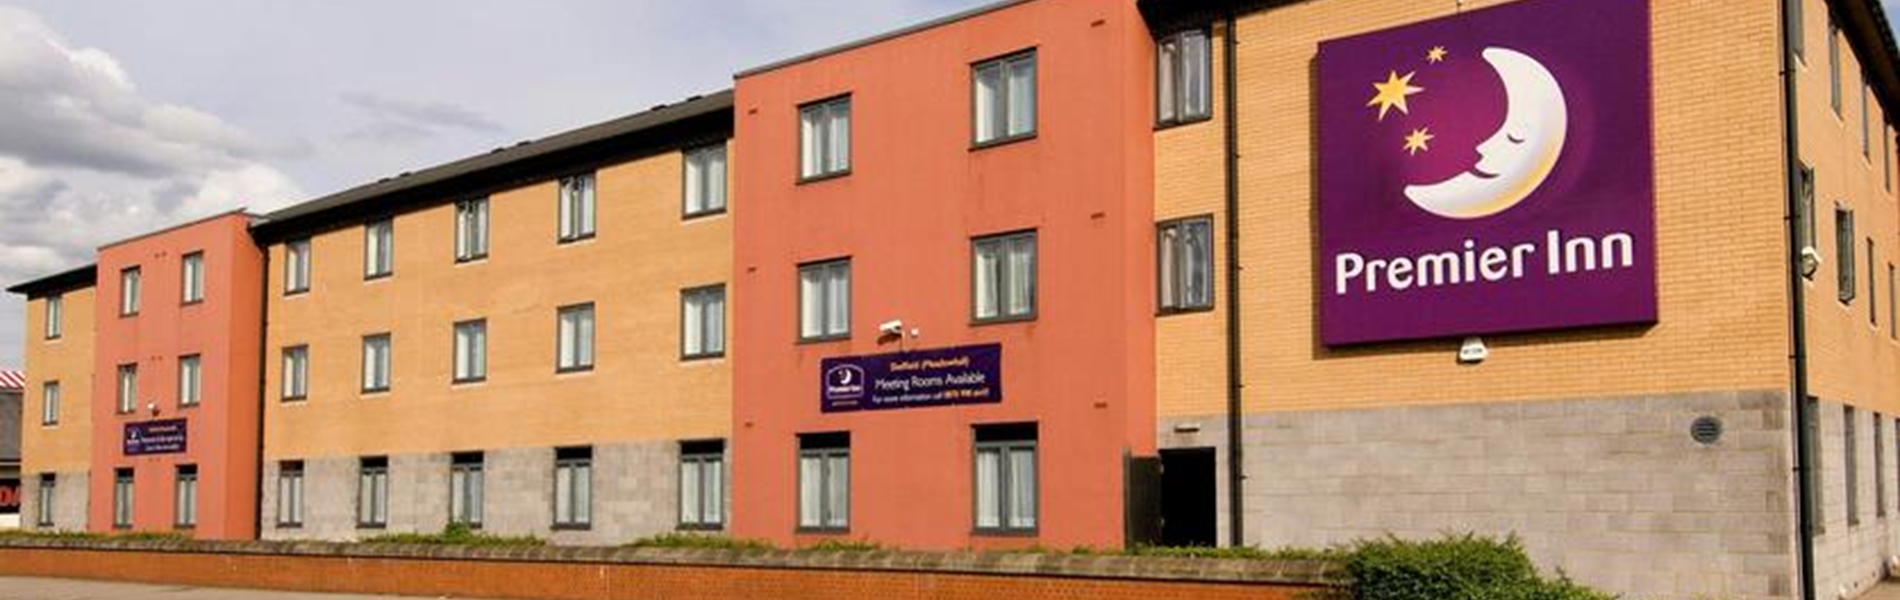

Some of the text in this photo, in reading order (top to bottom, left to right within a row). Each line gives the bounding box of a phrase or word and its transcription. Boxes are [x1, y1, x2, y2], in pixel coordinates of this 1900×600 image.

[1335, 229, 1634, 294] Premier Inn
[874, 371, 985, 392] Meeting Rooms Available
